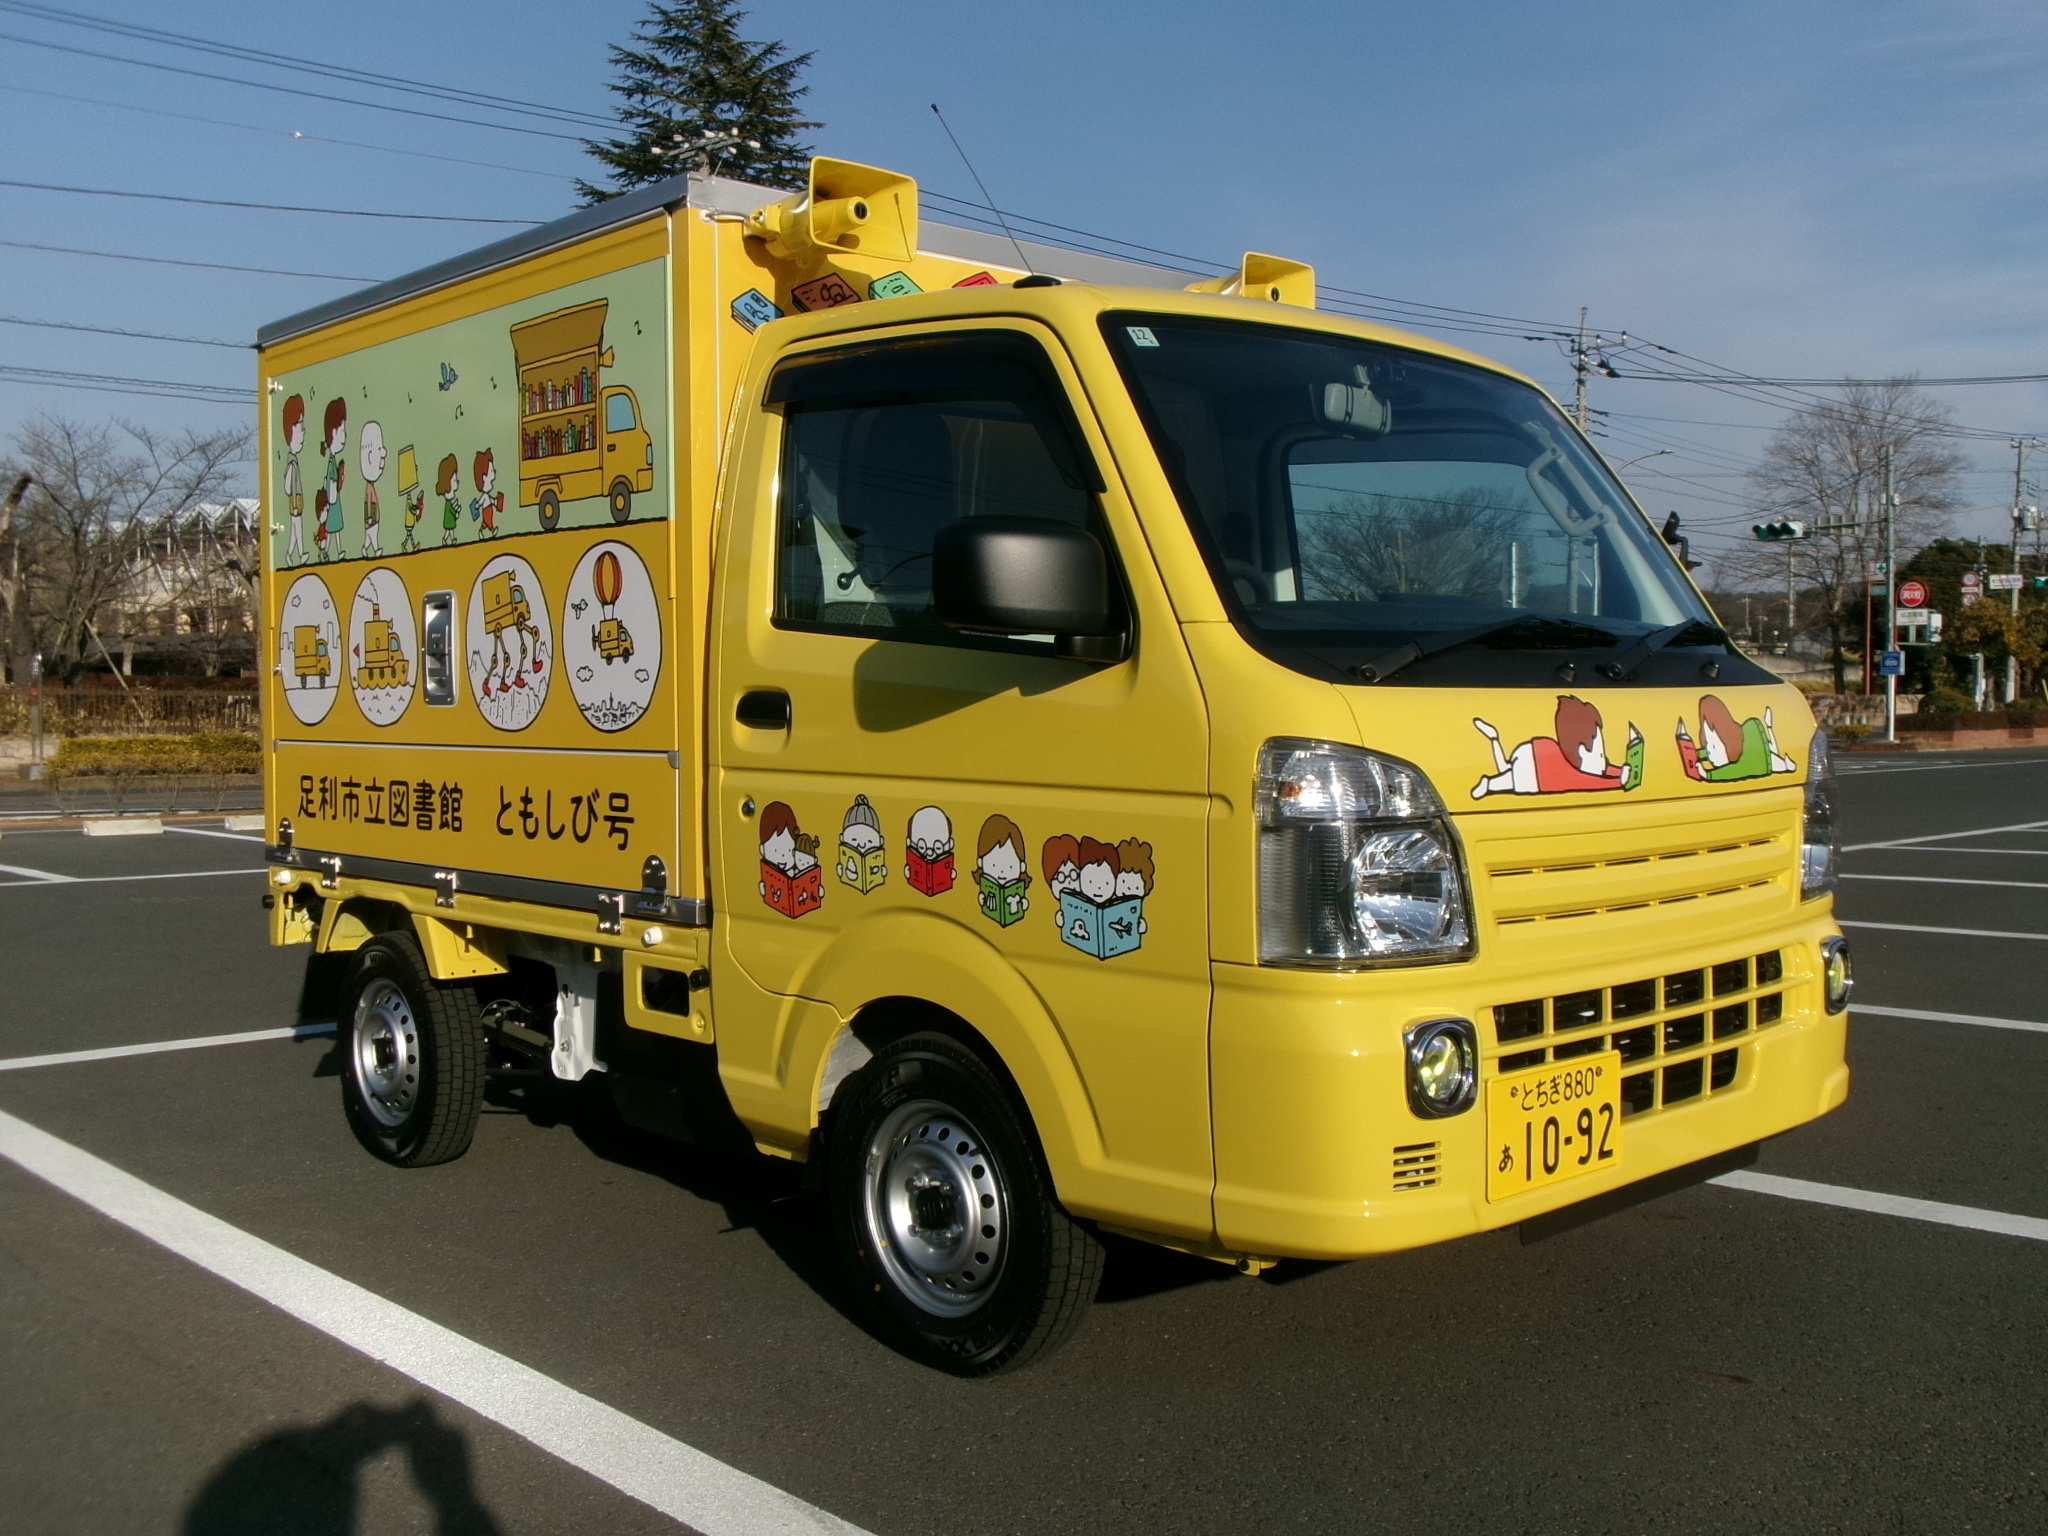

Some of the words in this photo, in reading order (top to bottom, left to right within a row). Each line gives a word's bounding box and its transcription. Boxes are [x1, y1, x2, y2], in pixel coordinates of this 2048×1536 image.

[1131, 329, 1149, 340] 12
[298, 775, 463, 832] 足利市立図書館
[496, 785, 635, 851] ともしび号
[1498, 1143, 1514, 1173] あ
[1526, 1102, 1614, 1181] 10-92
